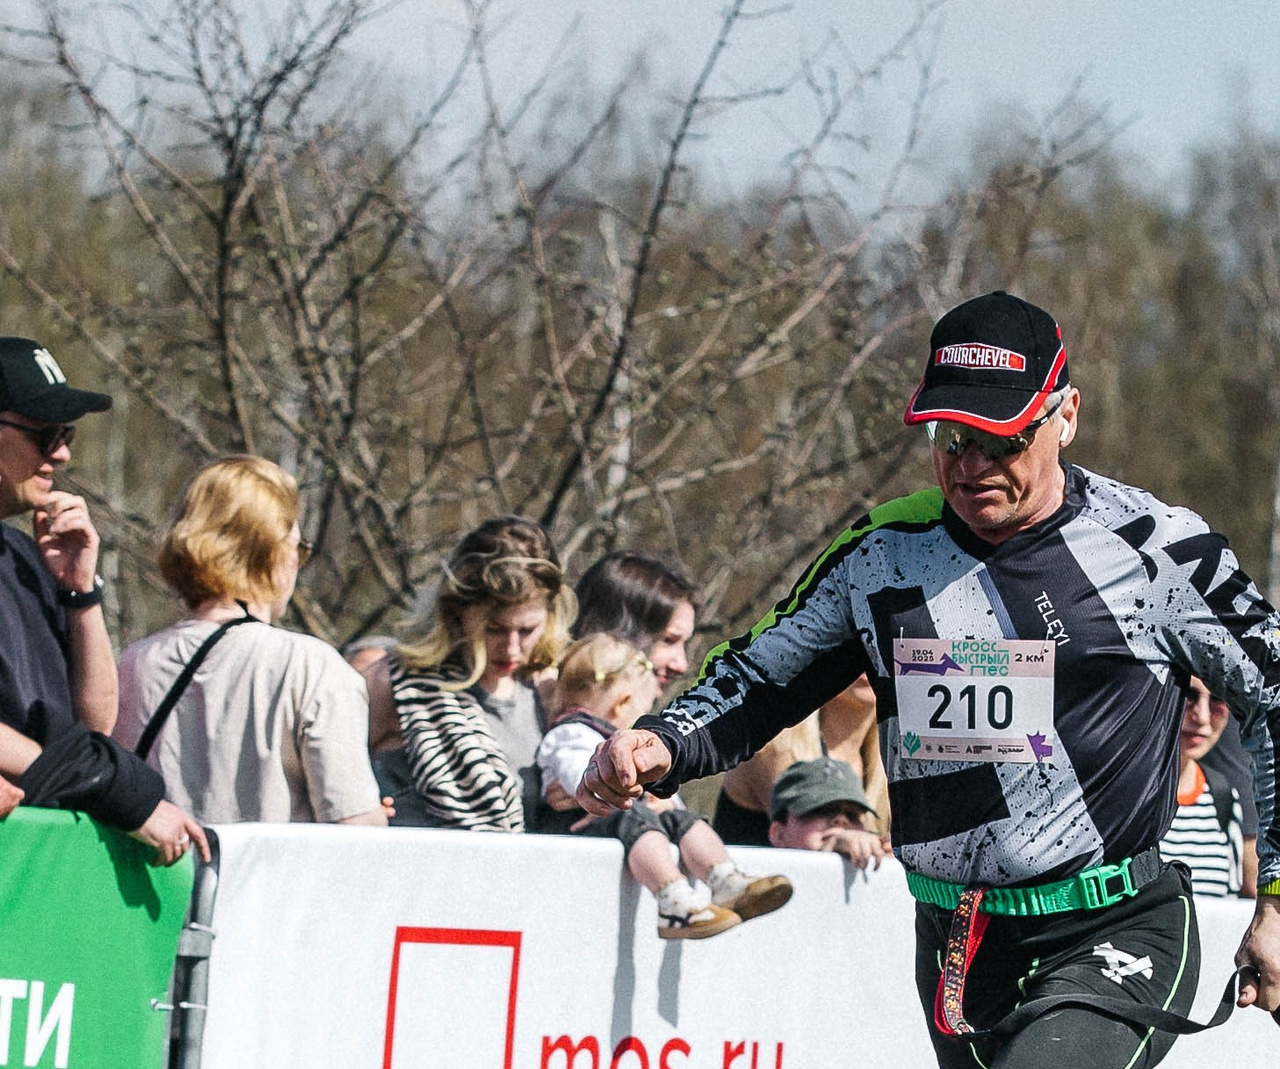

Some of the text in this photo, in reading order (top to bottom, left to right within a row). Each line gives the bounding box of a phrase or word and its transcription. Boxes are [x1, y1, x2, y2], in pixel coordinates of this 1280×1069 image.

[940, 346, 1010, 368] COURCHEVEL
[1015, 653, 1023, 662] 2
[927, 684, 1013, 730] 210
